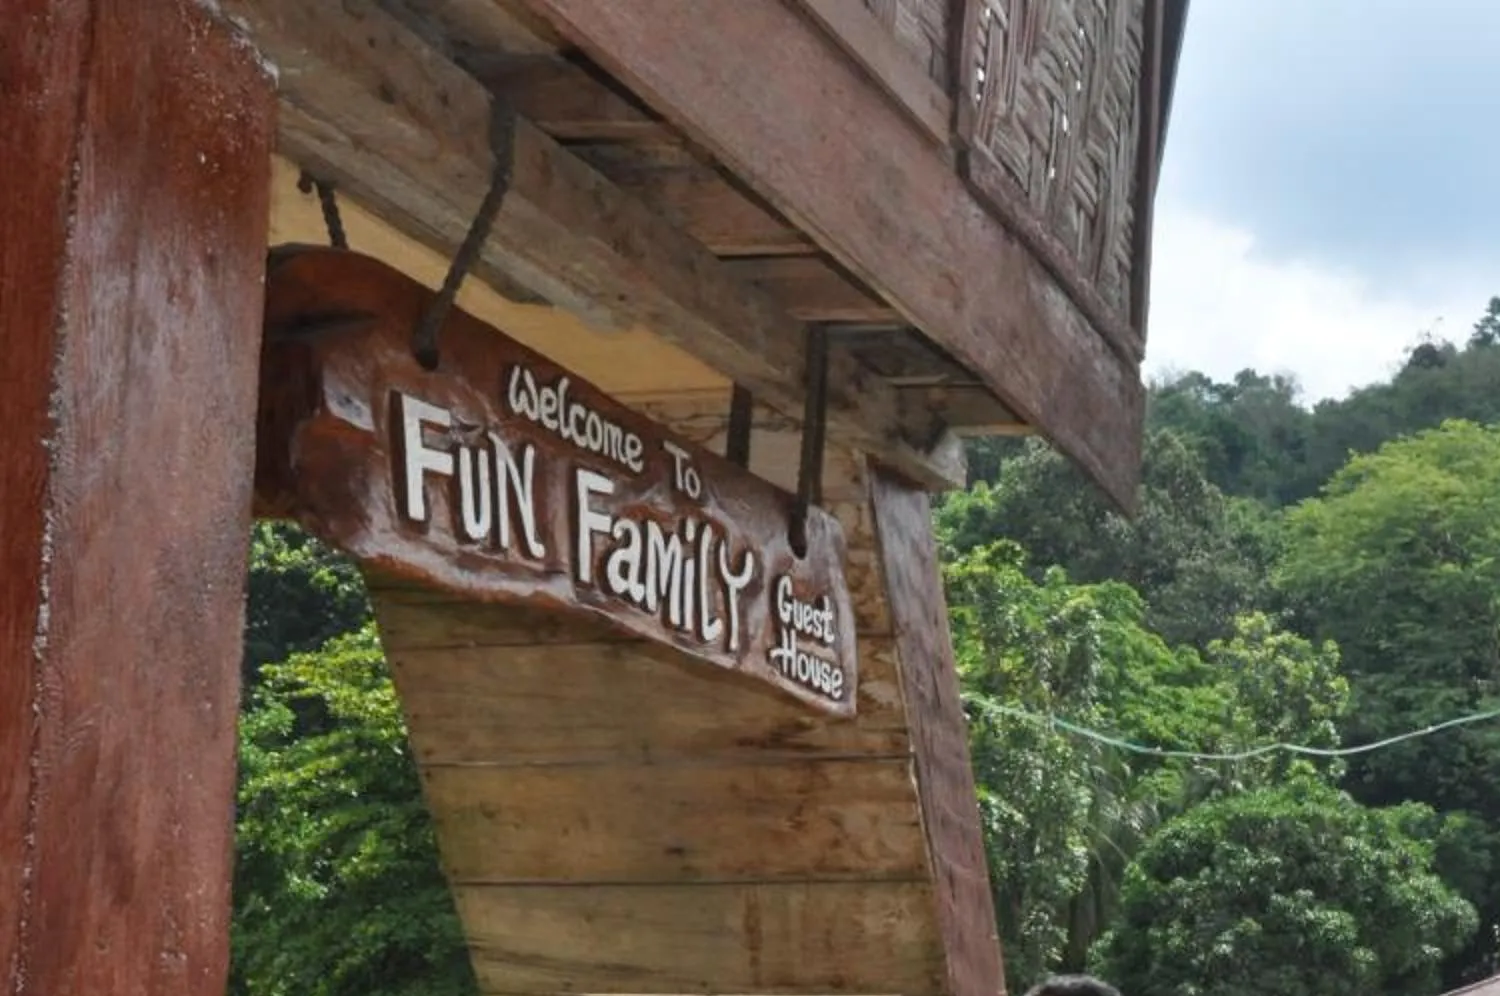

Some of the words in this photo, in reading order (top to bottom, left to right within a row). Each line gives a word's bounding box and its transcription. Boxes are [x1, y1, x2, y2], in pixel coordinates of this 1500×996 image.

[508, 365, 644, 473] Welcome
[663, 440, 701, 499] To
[778, 575, 835, 643] Guest
[769, 626, 843, 699] House
